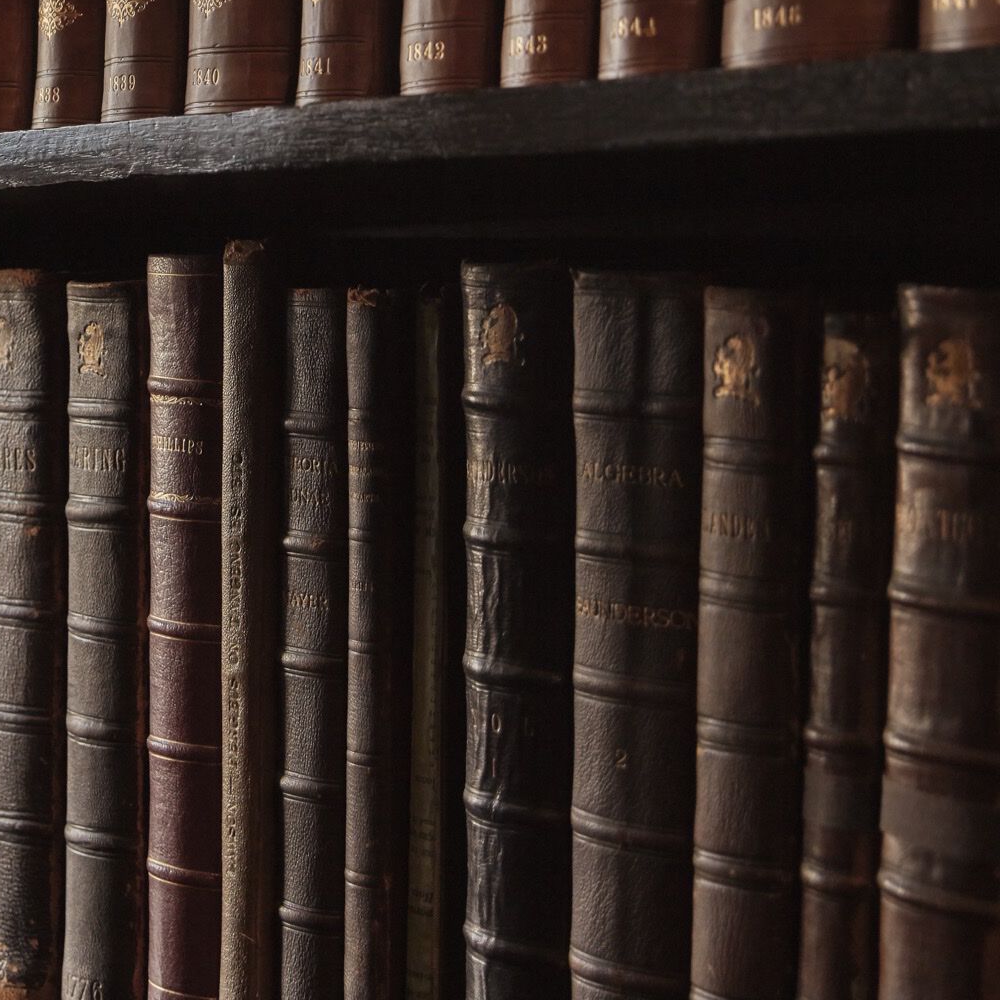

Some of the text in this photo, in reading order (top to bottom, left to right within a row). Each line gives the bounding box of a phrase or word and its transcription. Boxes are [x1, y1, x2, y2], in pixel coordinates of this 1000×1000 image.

[753, 3, 804, 32] 1846
[191, 67, 220, 86] 1840
[68, 443, 127, 473] ARING
[582, 461, 685, 489] ALGEBRA
